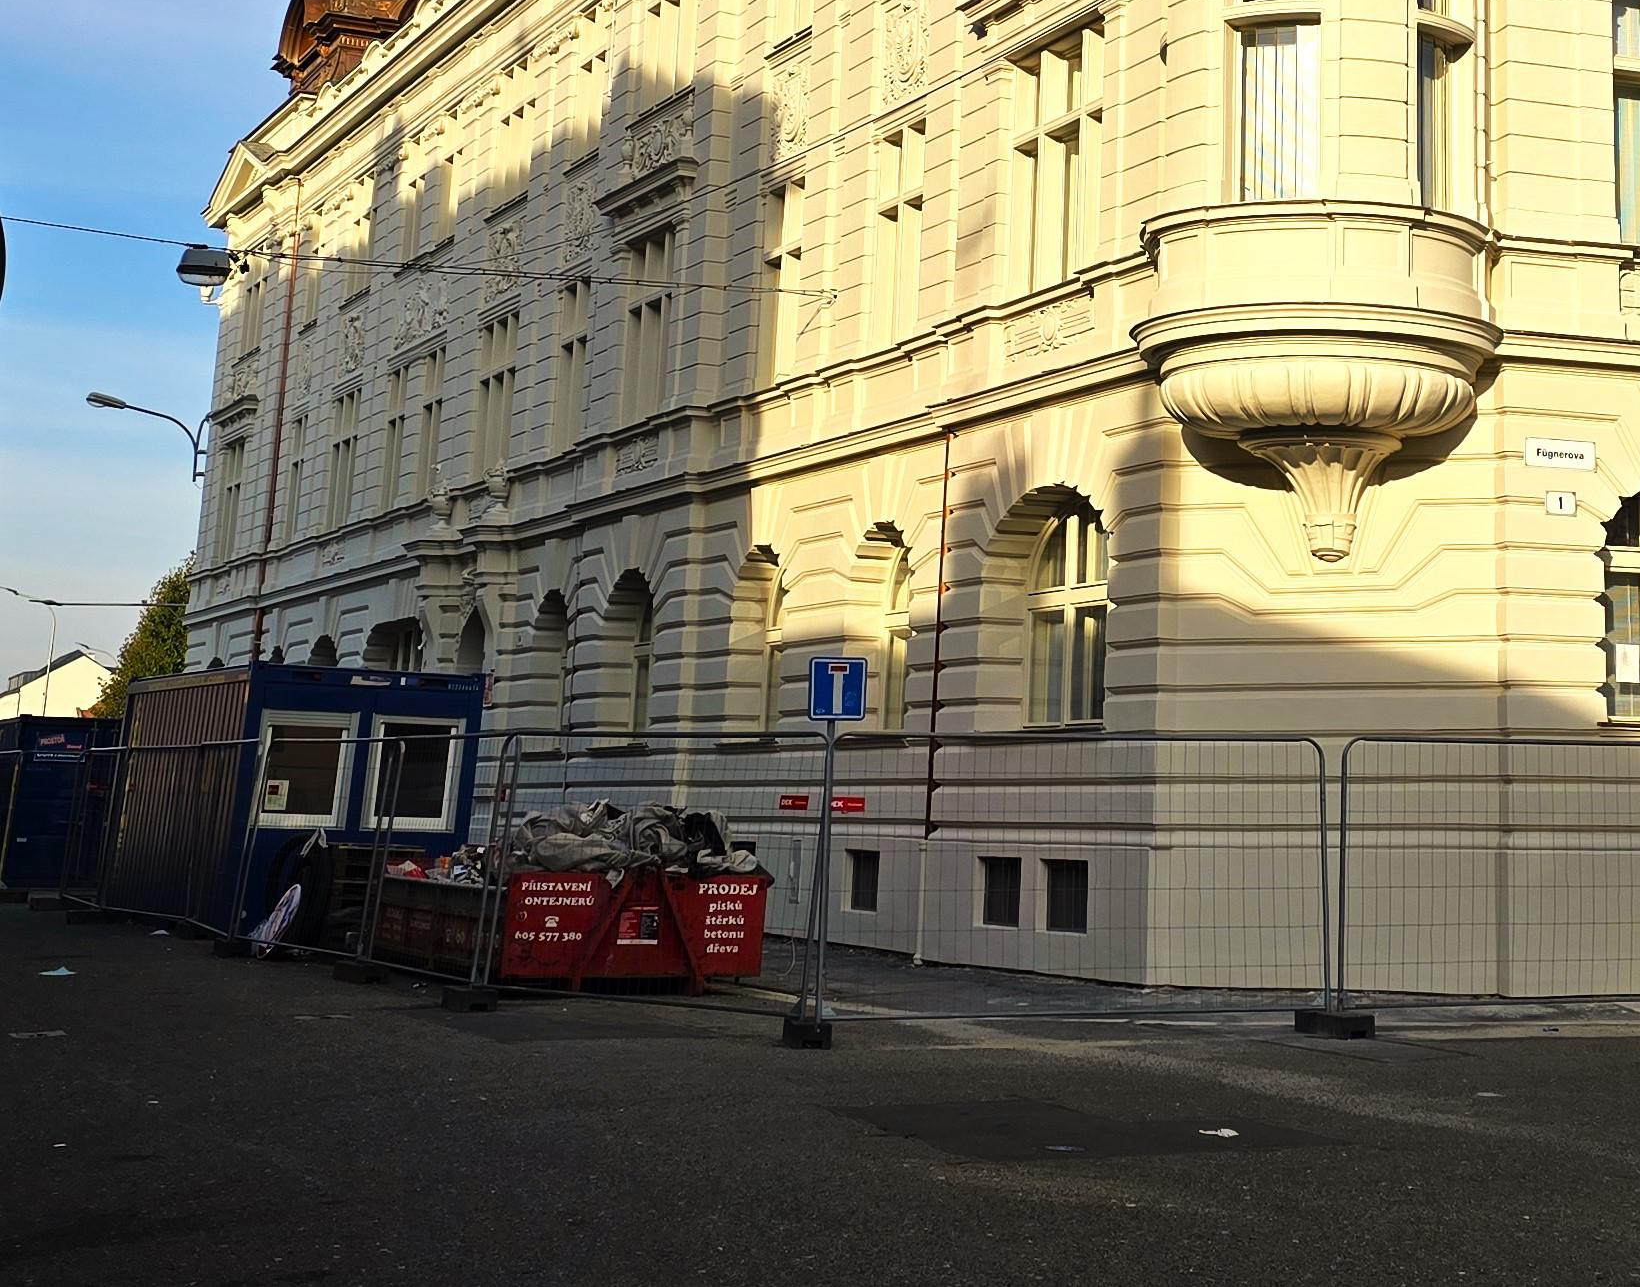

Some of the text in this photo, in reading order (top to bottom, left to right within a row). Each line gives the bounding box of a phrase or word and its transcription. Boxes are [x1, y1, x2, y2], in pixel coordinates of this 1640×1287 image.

[1536, 448, 1585, 460] Fügnerova
[1558, 496, 1563, 510] 1
[698, 883, 759, 896] PRODEJ
[518, 895, 595, 906] ONTEJNERŮ
[705, 914, 745, 925] štěrků
[538, 931, 560, 942] 577
[561, 931, 583, 942] 380
[704, 928, 745, 939] betonu
[706, 943, 739, 954] dřeva
